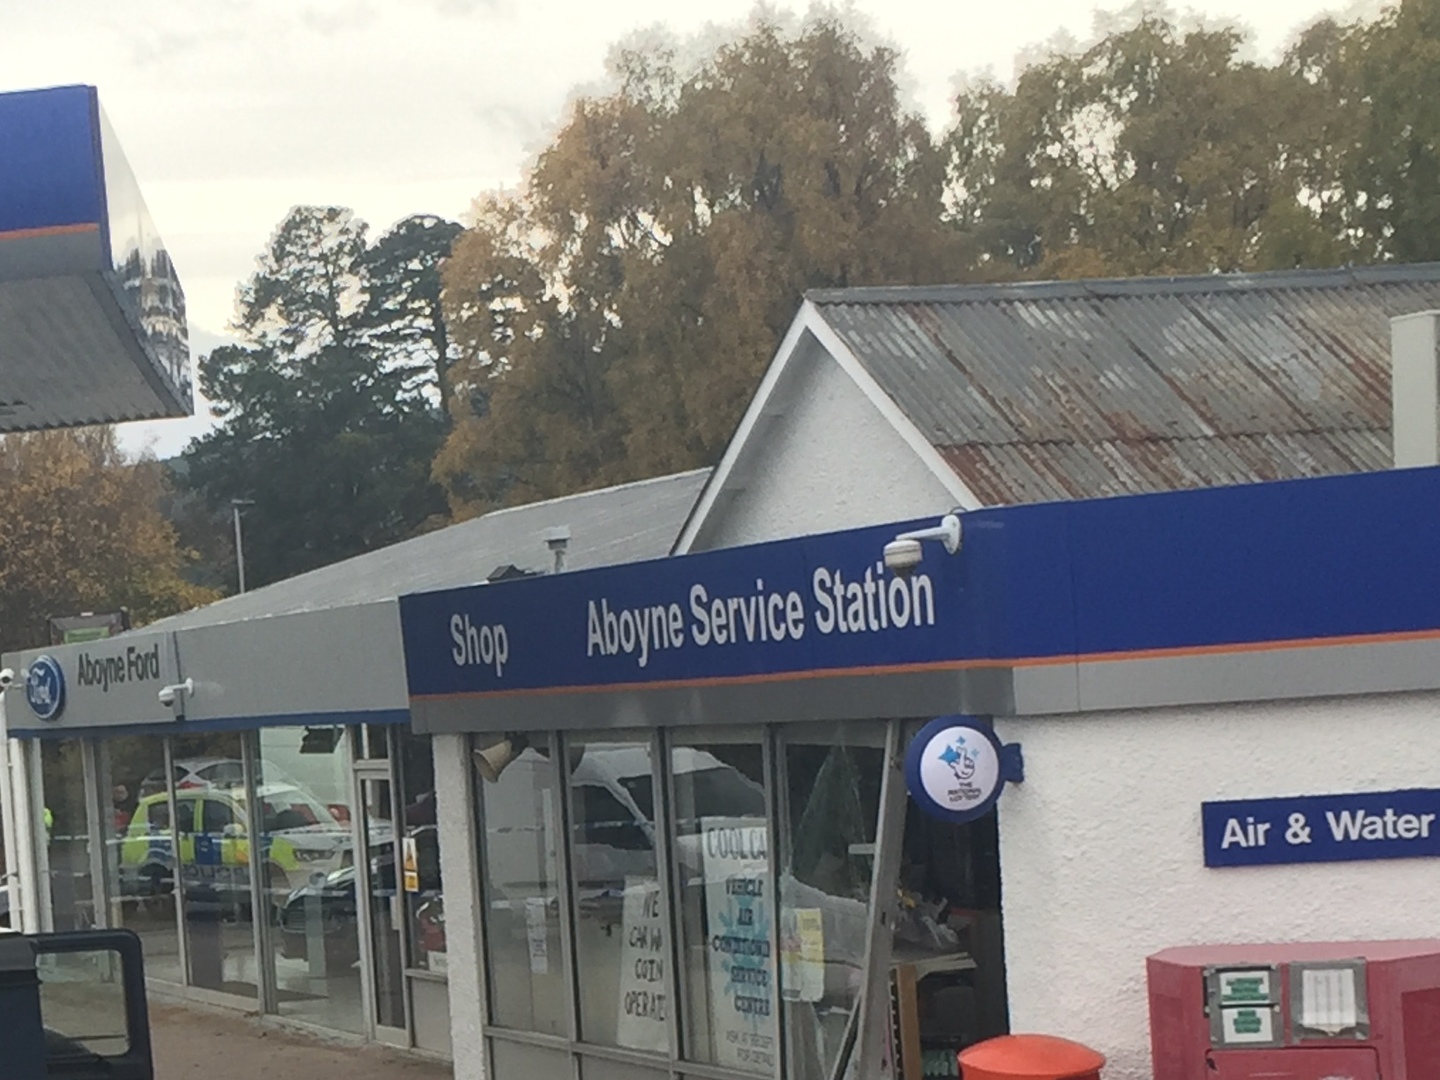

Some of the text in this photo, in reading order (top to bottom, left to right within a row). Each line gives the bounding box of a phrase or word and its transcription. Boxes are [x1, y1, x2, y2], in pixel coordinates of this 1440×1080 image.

[587, 561, 935, 667] Aboyne Service Station
[77, 643, 160, 692] Aboyne Ford
[450, 613, 509, 677] Shop
[750, 828, 767, 860] CA
[1221, 808, 1435, 849] Air & Water
